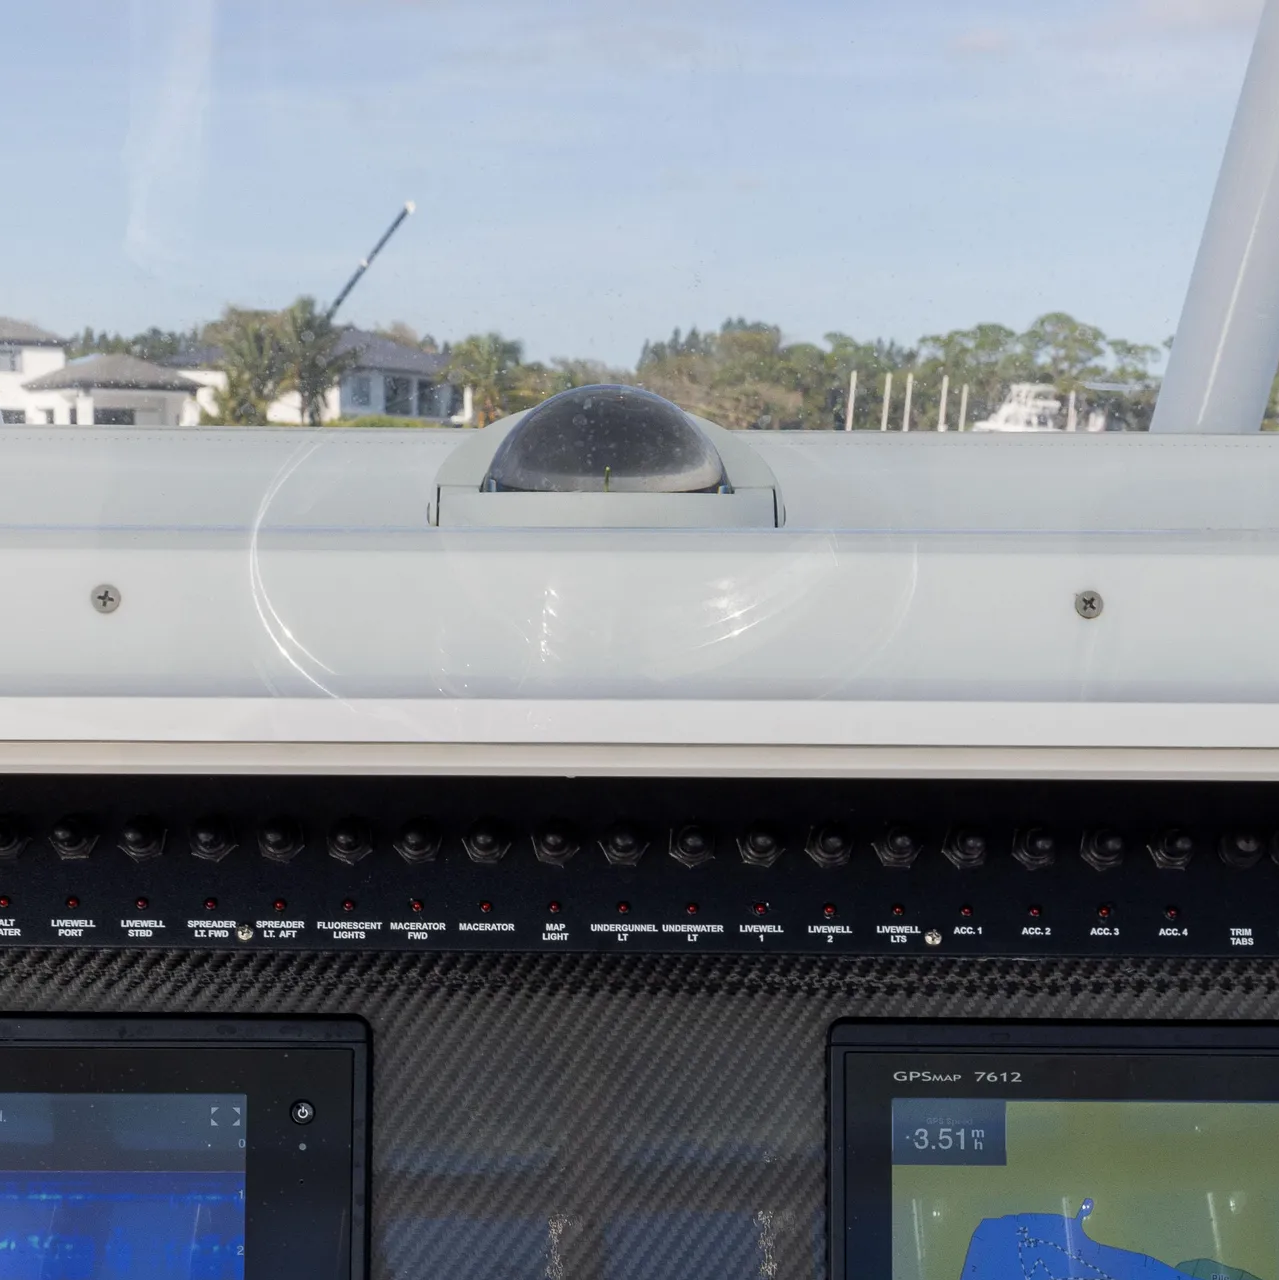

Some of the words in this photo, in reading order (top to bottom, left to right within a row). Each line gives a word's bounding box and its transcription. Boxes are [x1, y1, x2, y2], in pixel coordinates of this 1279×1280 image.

[121, 920, 165, 930] LIVEWELL
[188, 920, 236, 928] SPREADER
[256, 921, 304, 931] SPREADER
[390, 922, 446, 930] MACERATOR
[459, 923, 514, 931] MACERATOR
[546, 923, 565, 931] MAP
[591, 924, 658, 932] UNDERGUNNEL
[662, 924, 724, 932] UNDERWATER
[128, 929, 153, 937] STBD
[279, 930, 297, 938] AFT
[333, 931, 365, 939] LIGHTS
[1022, 927, 1043, 935] ACC.
[1159, 928, 1180, 936] ACC.
[1182, 928, 1188, 936] 4
[1230, 928, 1252, 936] TRIM
[759, 934, 763, 942] 1
[891, 935, 907, 943] LTS
[893, 1071, 962, 1082] GPSMAP
[974, 1071, 1023, 1083] 7612
[913, 1128, 965, 1150] 3.51
